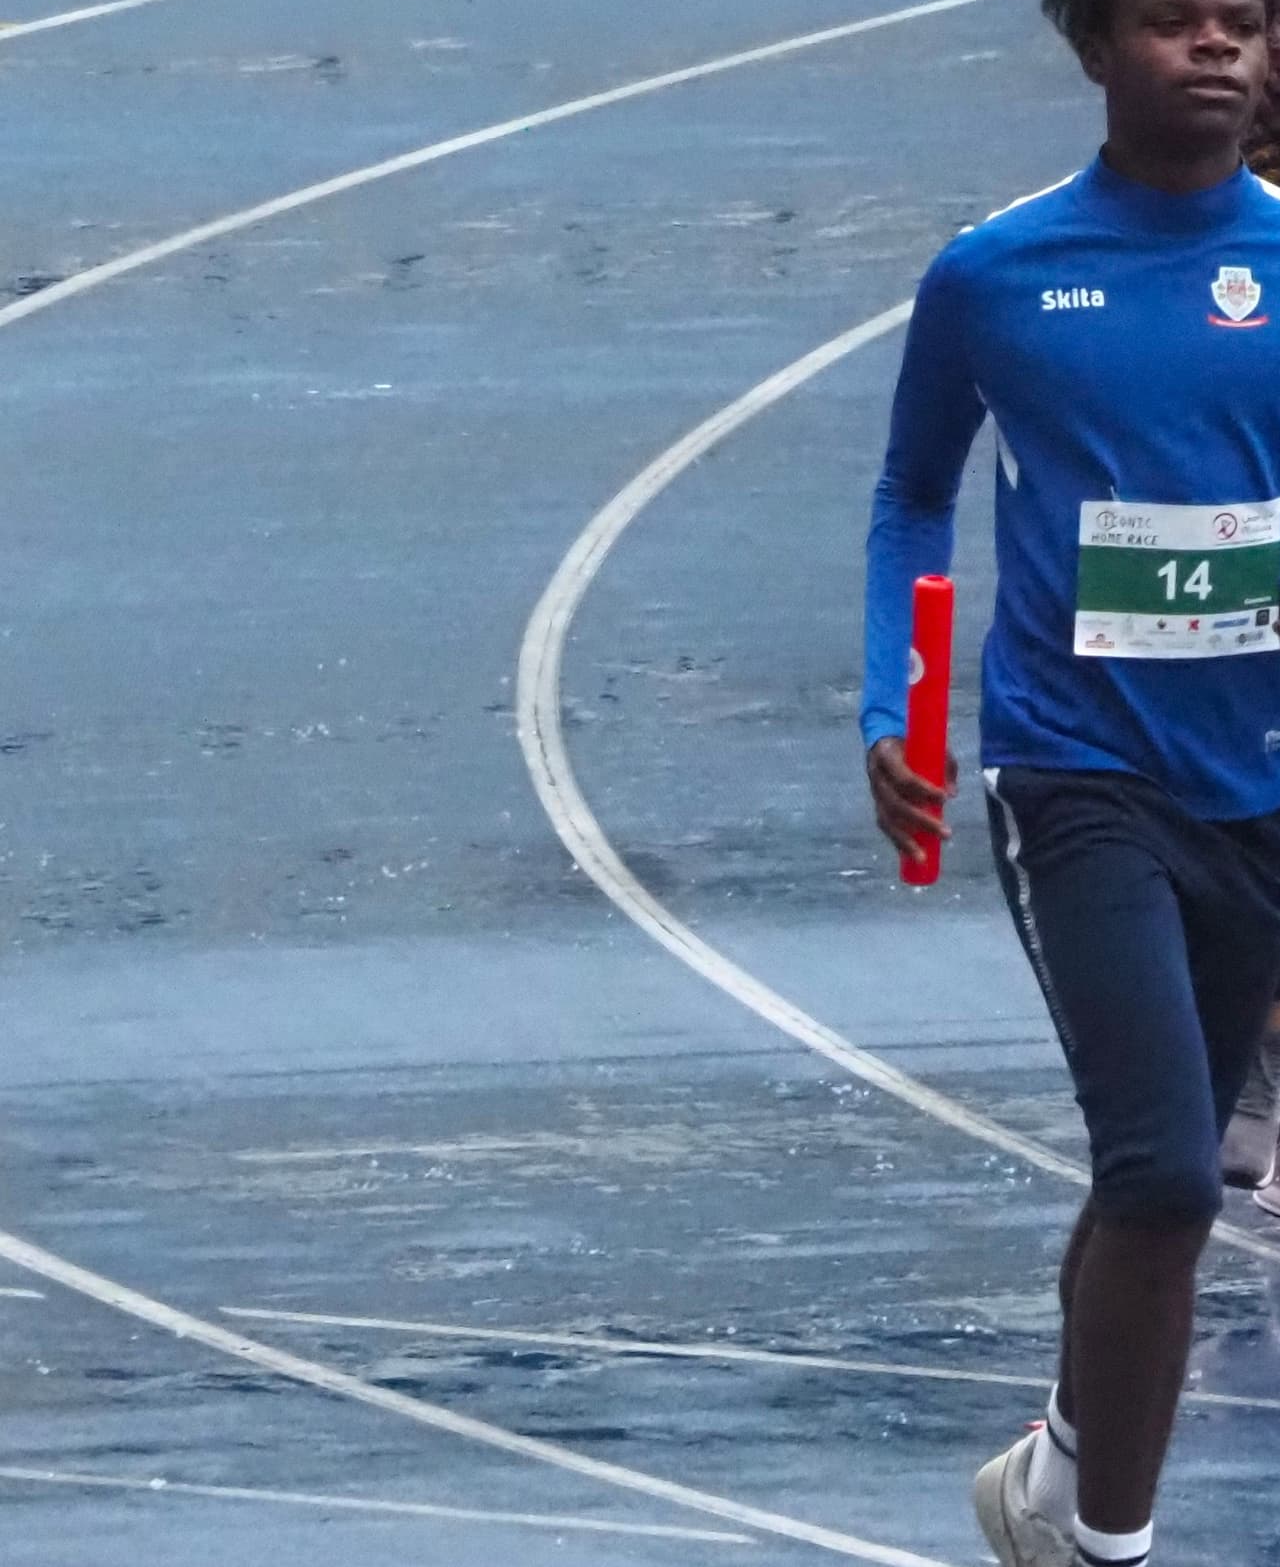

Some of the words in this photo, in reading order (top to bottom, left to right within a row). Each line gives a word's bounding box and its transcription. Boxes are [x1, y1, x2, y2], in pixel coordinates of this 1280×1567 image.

[1041, 287, 1105, 311] Skita
[1091, 533, 1123, 544] HOME
[1127, 534, 1159, 545] RACE
[1157, 560, 1213, 600] 14
